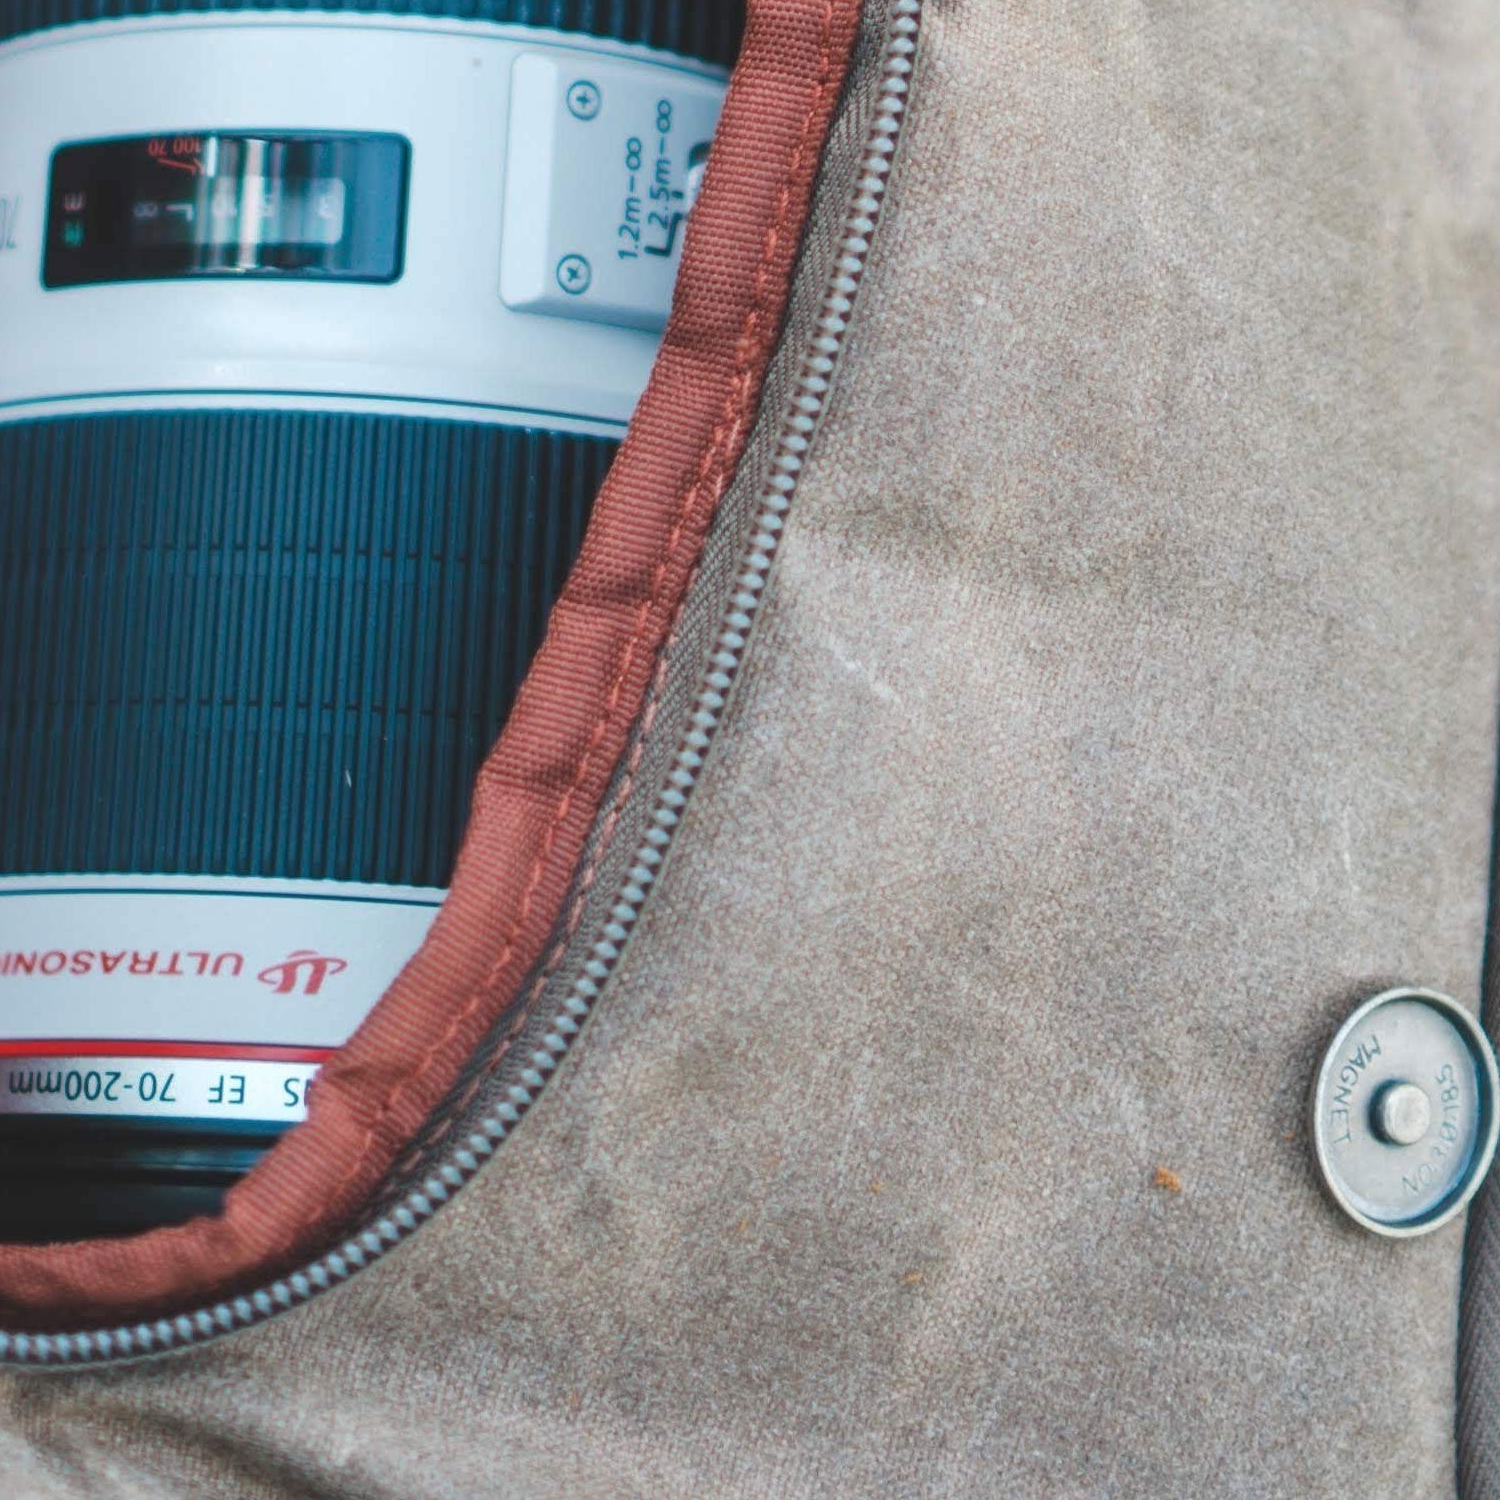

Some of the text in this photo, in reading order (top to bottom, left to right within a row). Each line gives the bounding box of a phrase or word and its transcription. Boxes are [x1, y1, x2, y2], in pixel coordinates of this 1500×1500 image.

[8, 1069, 178, 1103] 70-200mm
[208, 1074, 246, 1104] EF
[1330, 1033, 1382, 1145] MAGNET
